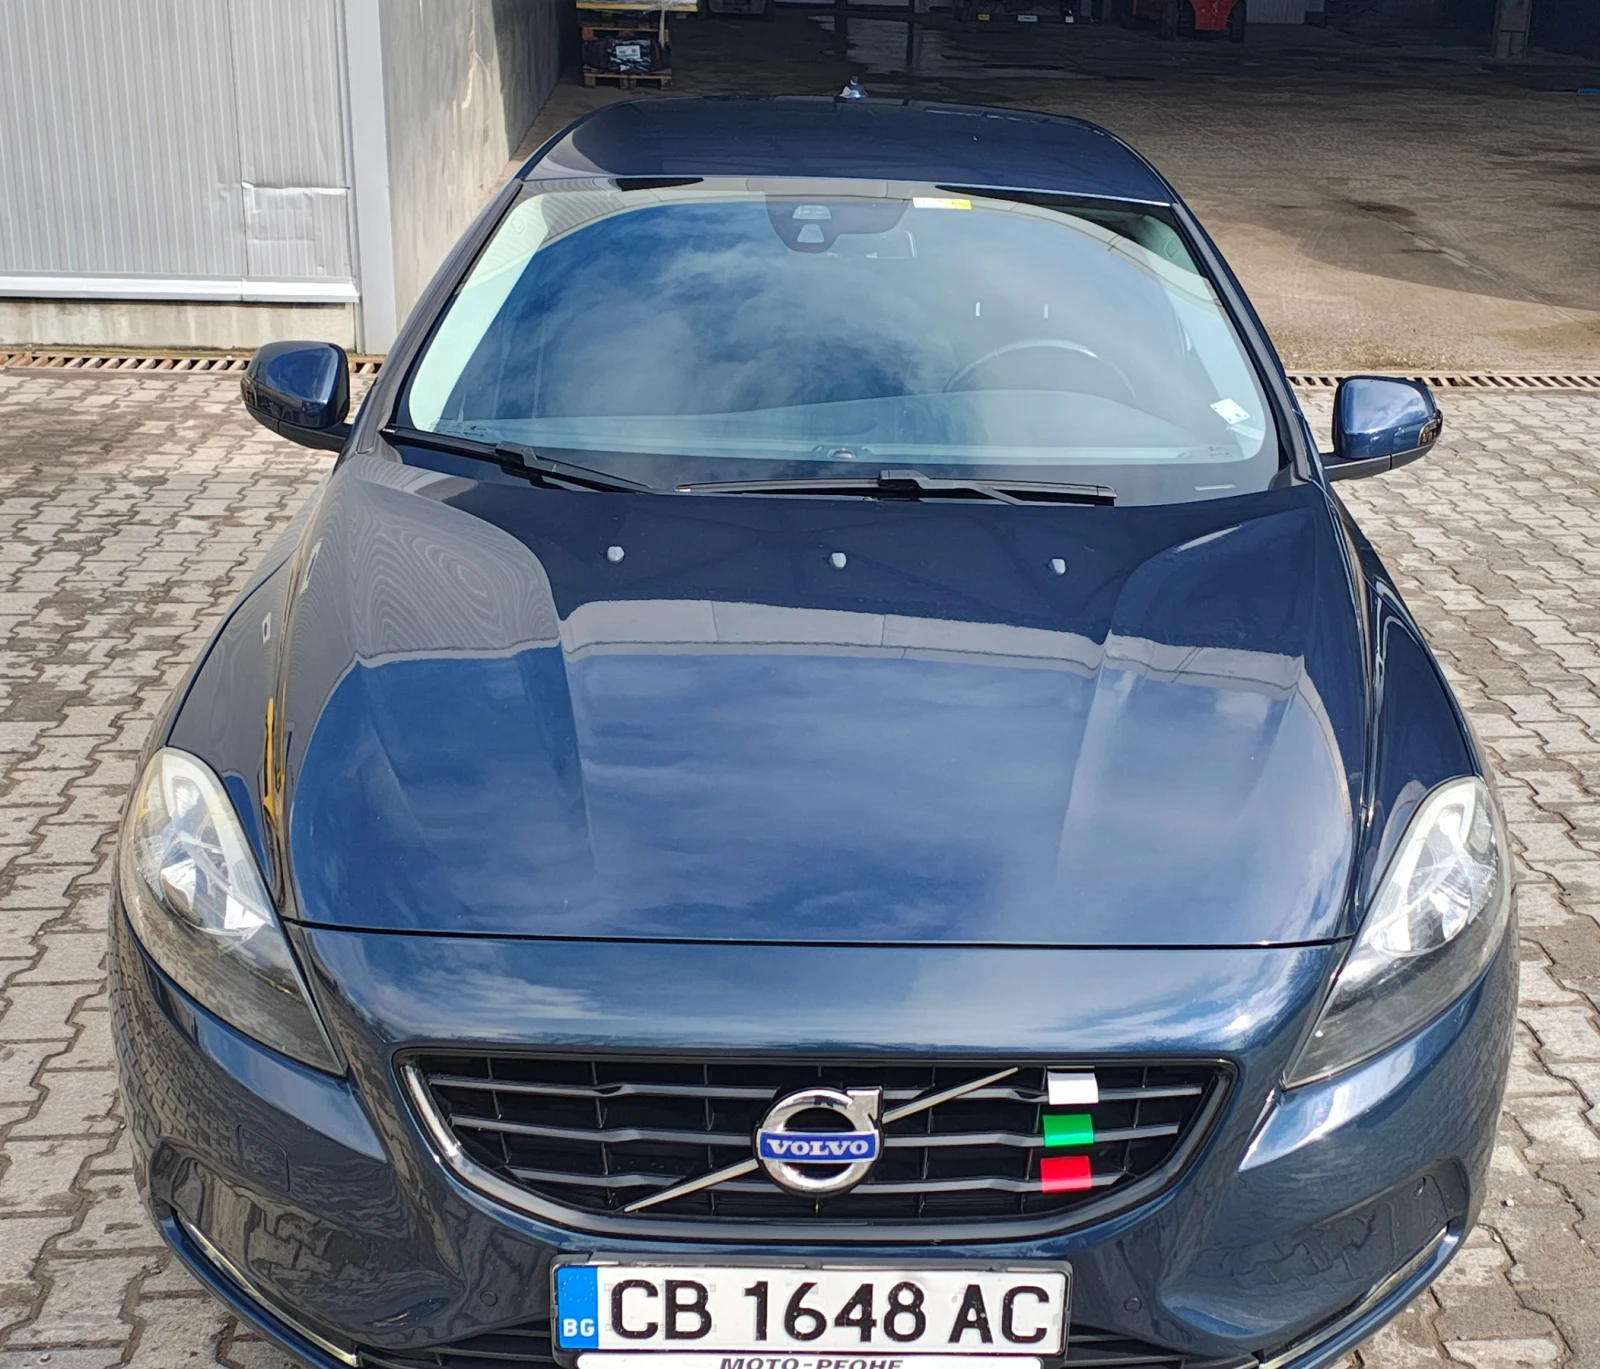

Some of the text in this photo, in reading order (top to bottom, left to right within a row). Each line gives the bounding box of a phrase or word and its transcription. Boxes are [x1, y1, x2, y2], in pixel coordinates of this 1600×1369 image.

[766, 1138, 869, 1157] VOLVO
[611, 1279, 1049, 1344] CB 1648 AC
[563, 1318, 595, 1337] BG
